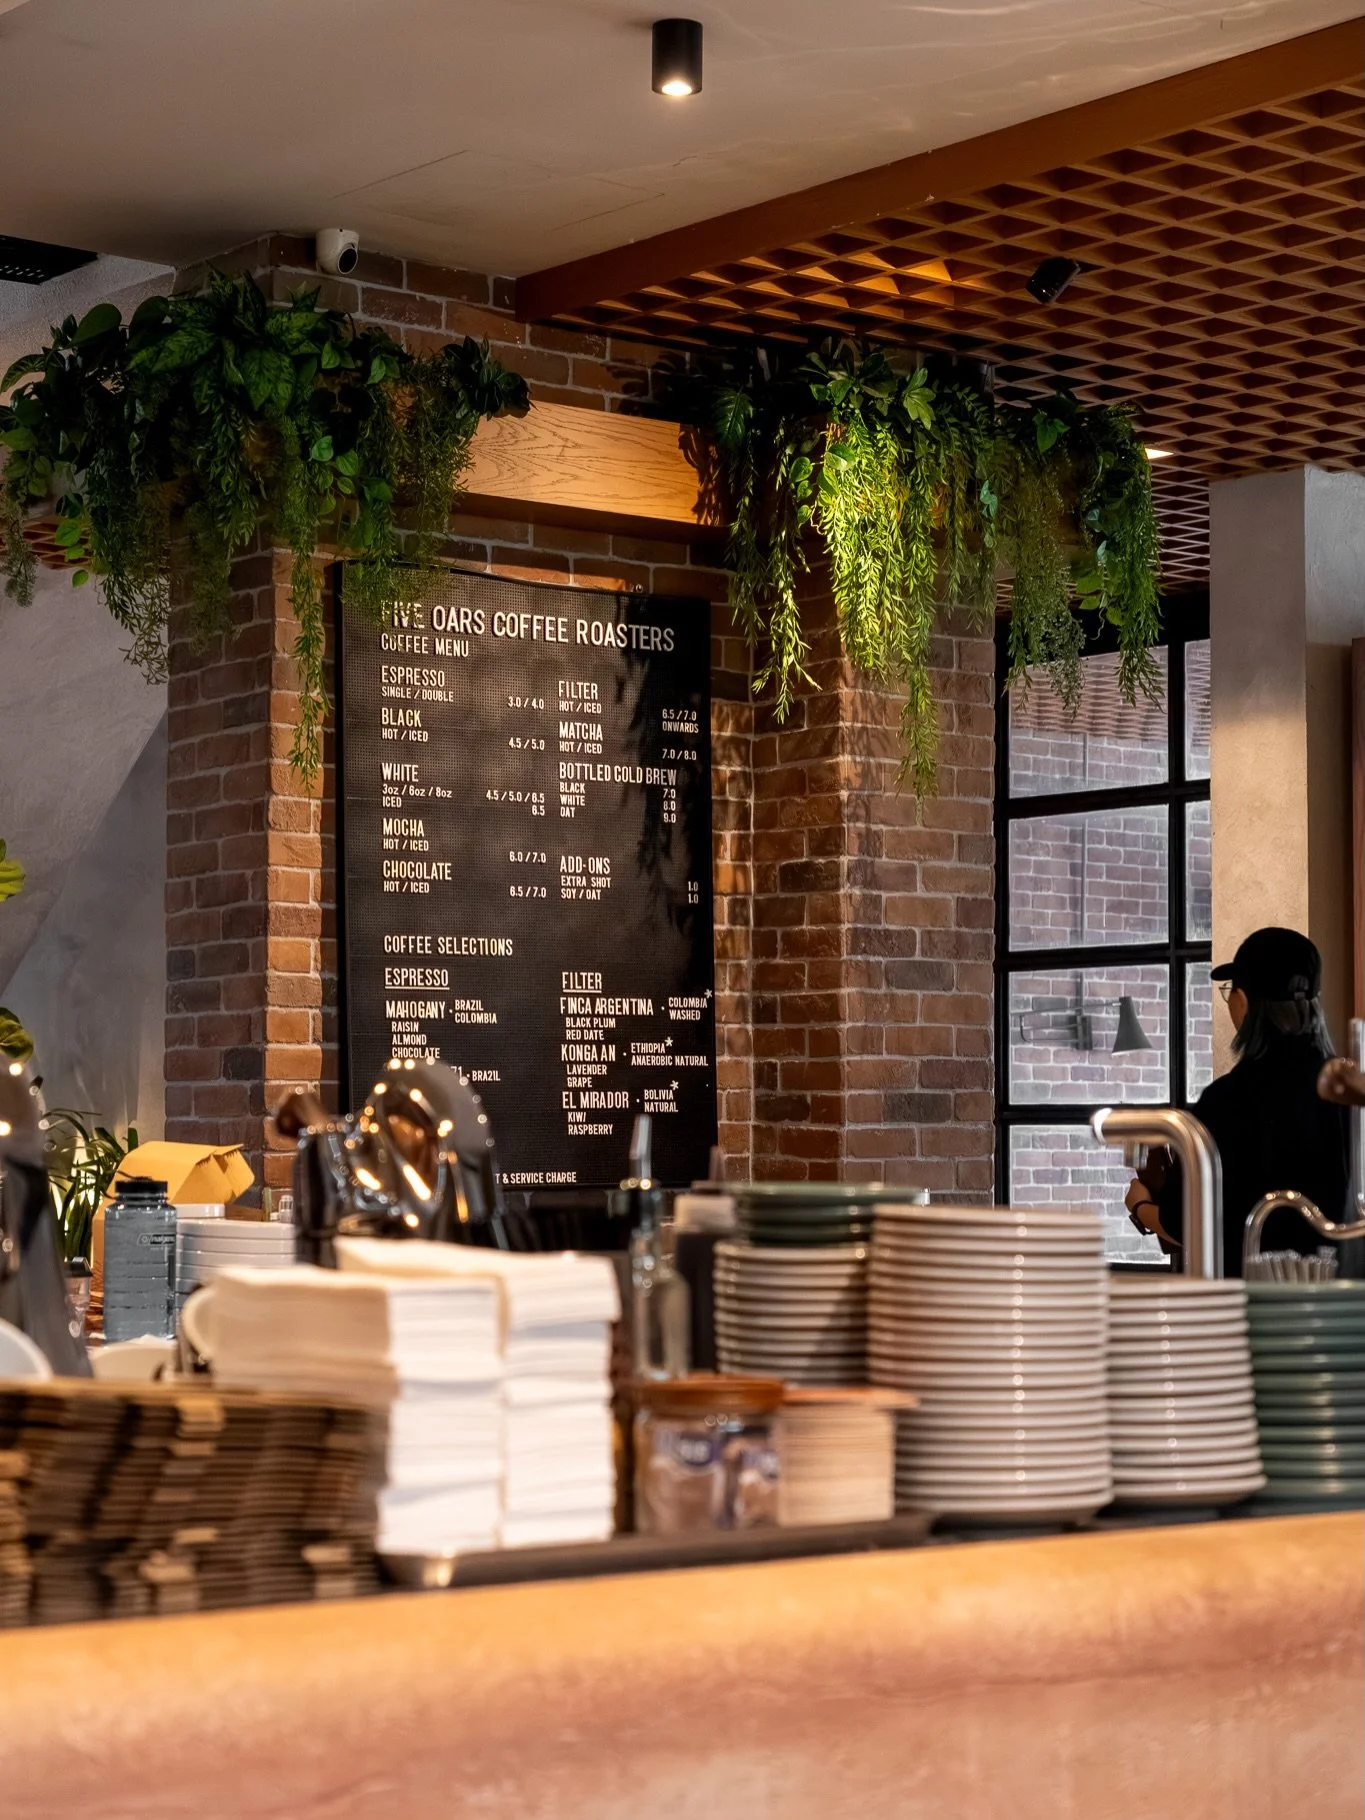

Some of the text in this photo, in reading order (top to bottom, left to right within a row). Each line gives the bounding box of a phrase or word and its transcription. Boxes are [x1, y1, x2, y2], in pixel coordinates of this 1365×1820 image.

[432, 605, 485, 635] OARS
[493, 612, 569, 644] COFFEE
[576, 619, 675, 652] ROASTERS
[381, 633, 469, 657] COFFEE MENU
[381, 665, 445, 687] ESPRESSO
[381, 687, 411, 699] SINGLE
[422, 689, 454, 702] DOUBLE
[558, 681, 598, 700] FILTER
[508, 696, 521, 707] 3.0
[531, 698, 544, 710] 4.0
[559, 701, 575, 712] HOT
[584, 703, 602, 714] ICED
[381, 707, 422, 727] BLACK
[662, 709, 674, 719] 6.5
[683, 711, 697, 720] 7.0
[559, 721, 603, 741] MATCHA
[662, 721, 699, 733] ONWARDS
[381, 729, 398, 740] HOT
[409, 730, 428, 742] ICED
[508, 738, 521, 749] 4.5
[531, 739, 545, 750] 5.0
[559, 741, 575, 752] HOT
[584, 743, 602, 754] ICED
[662, 749, 674, 759] 7.0
[684, 751, 697, 760] 8.0
[381, 762, 419, 782] WHITE
[560, 762, 677, 786] BOTTLED COLD BREW
[382, 784, 399, 796] 3oz
[409, 785, 426, 797] 6oz
[435, 787, 452, 798] 8oz
[560, 782, 586, 794] BLACK
[662, 789, 676, 799] 7.0
[382, 796, 402, 808] ICED
[486, 790, 499, 801] 4.5
[508, 791, 522, 802] 5.0
[560, 794, 586, 806] WHITE
[663, 801, 676, 811] 8.0
[560, 807, 575, 818] OAT
[663, 813, 676, 823] 9.0
[382, 818, 424, 837] MOCHA
[383, 839, 399, 850] HOT
[409, 840, 429, 851] ICED
[509, 851, 523, 862] 6.0
[532, 852, 546, 864] 7.0
[383, 860, 452, 880] CHOCOLATE
[383, 881, 400, 892] HOT
[410, 882, 429, 894] ICED
[561, 877, 611, 888] EXTRA SHOT
[688, 881, 698, 892] 1.0
[509, 887, 523, 897] 6.5
[532, 887, 547, 898] 7.0
[561, 889, 577, 899] SOY
[586, 889, 602, 900] OAT
[688, 893, 699, 904] 1.0
[384, 935, 513, 957] COFFEE SELECTIONS
[384, 967, 450, 986] ESPRESSO
[562, 972, 602, 990] FILTER
[386, 1000, 445, 1019] MAHOGANY
[454, 999, 484, 1011] BRAZIL
[560, 997, 654, 1016] FINCA ARGENTINA
[454, 1012, 497, 1024] COLOMBIA
[669, 1009, 701, 1021] WASHED
[391, 1022, 419, 1033] RAISIN
[565, 1017, 616, 1028] BLACK PLUM
[392, 1034, 427, 1045] ALMOND
[566, 1029, 604, 1041] RED DATE
[392, 1047, 440, 1059] CHOCOLATE
[631, 1042, 665, 1054] ETHIOPIA
[631, 1054, 708, 1066] ANAEROBIC NATURAL
[566, 1064, 607, 1075] LAVENDER
[567, 1077, 593, 1088] GRAPE
[562, 1091, 629, 1109] EL MIRADOR
[644, 1089, 674, 1101] BOLIVIA
[644, 1101, 679, 1113] NATURAL
[568, 1124, 613, 1136] RASPBERRY
[502, 1173, 509, 1184] &
[510, 1173, 543, 1184] SERVICE
[546, 1172, 577, 1183] CHARGE
